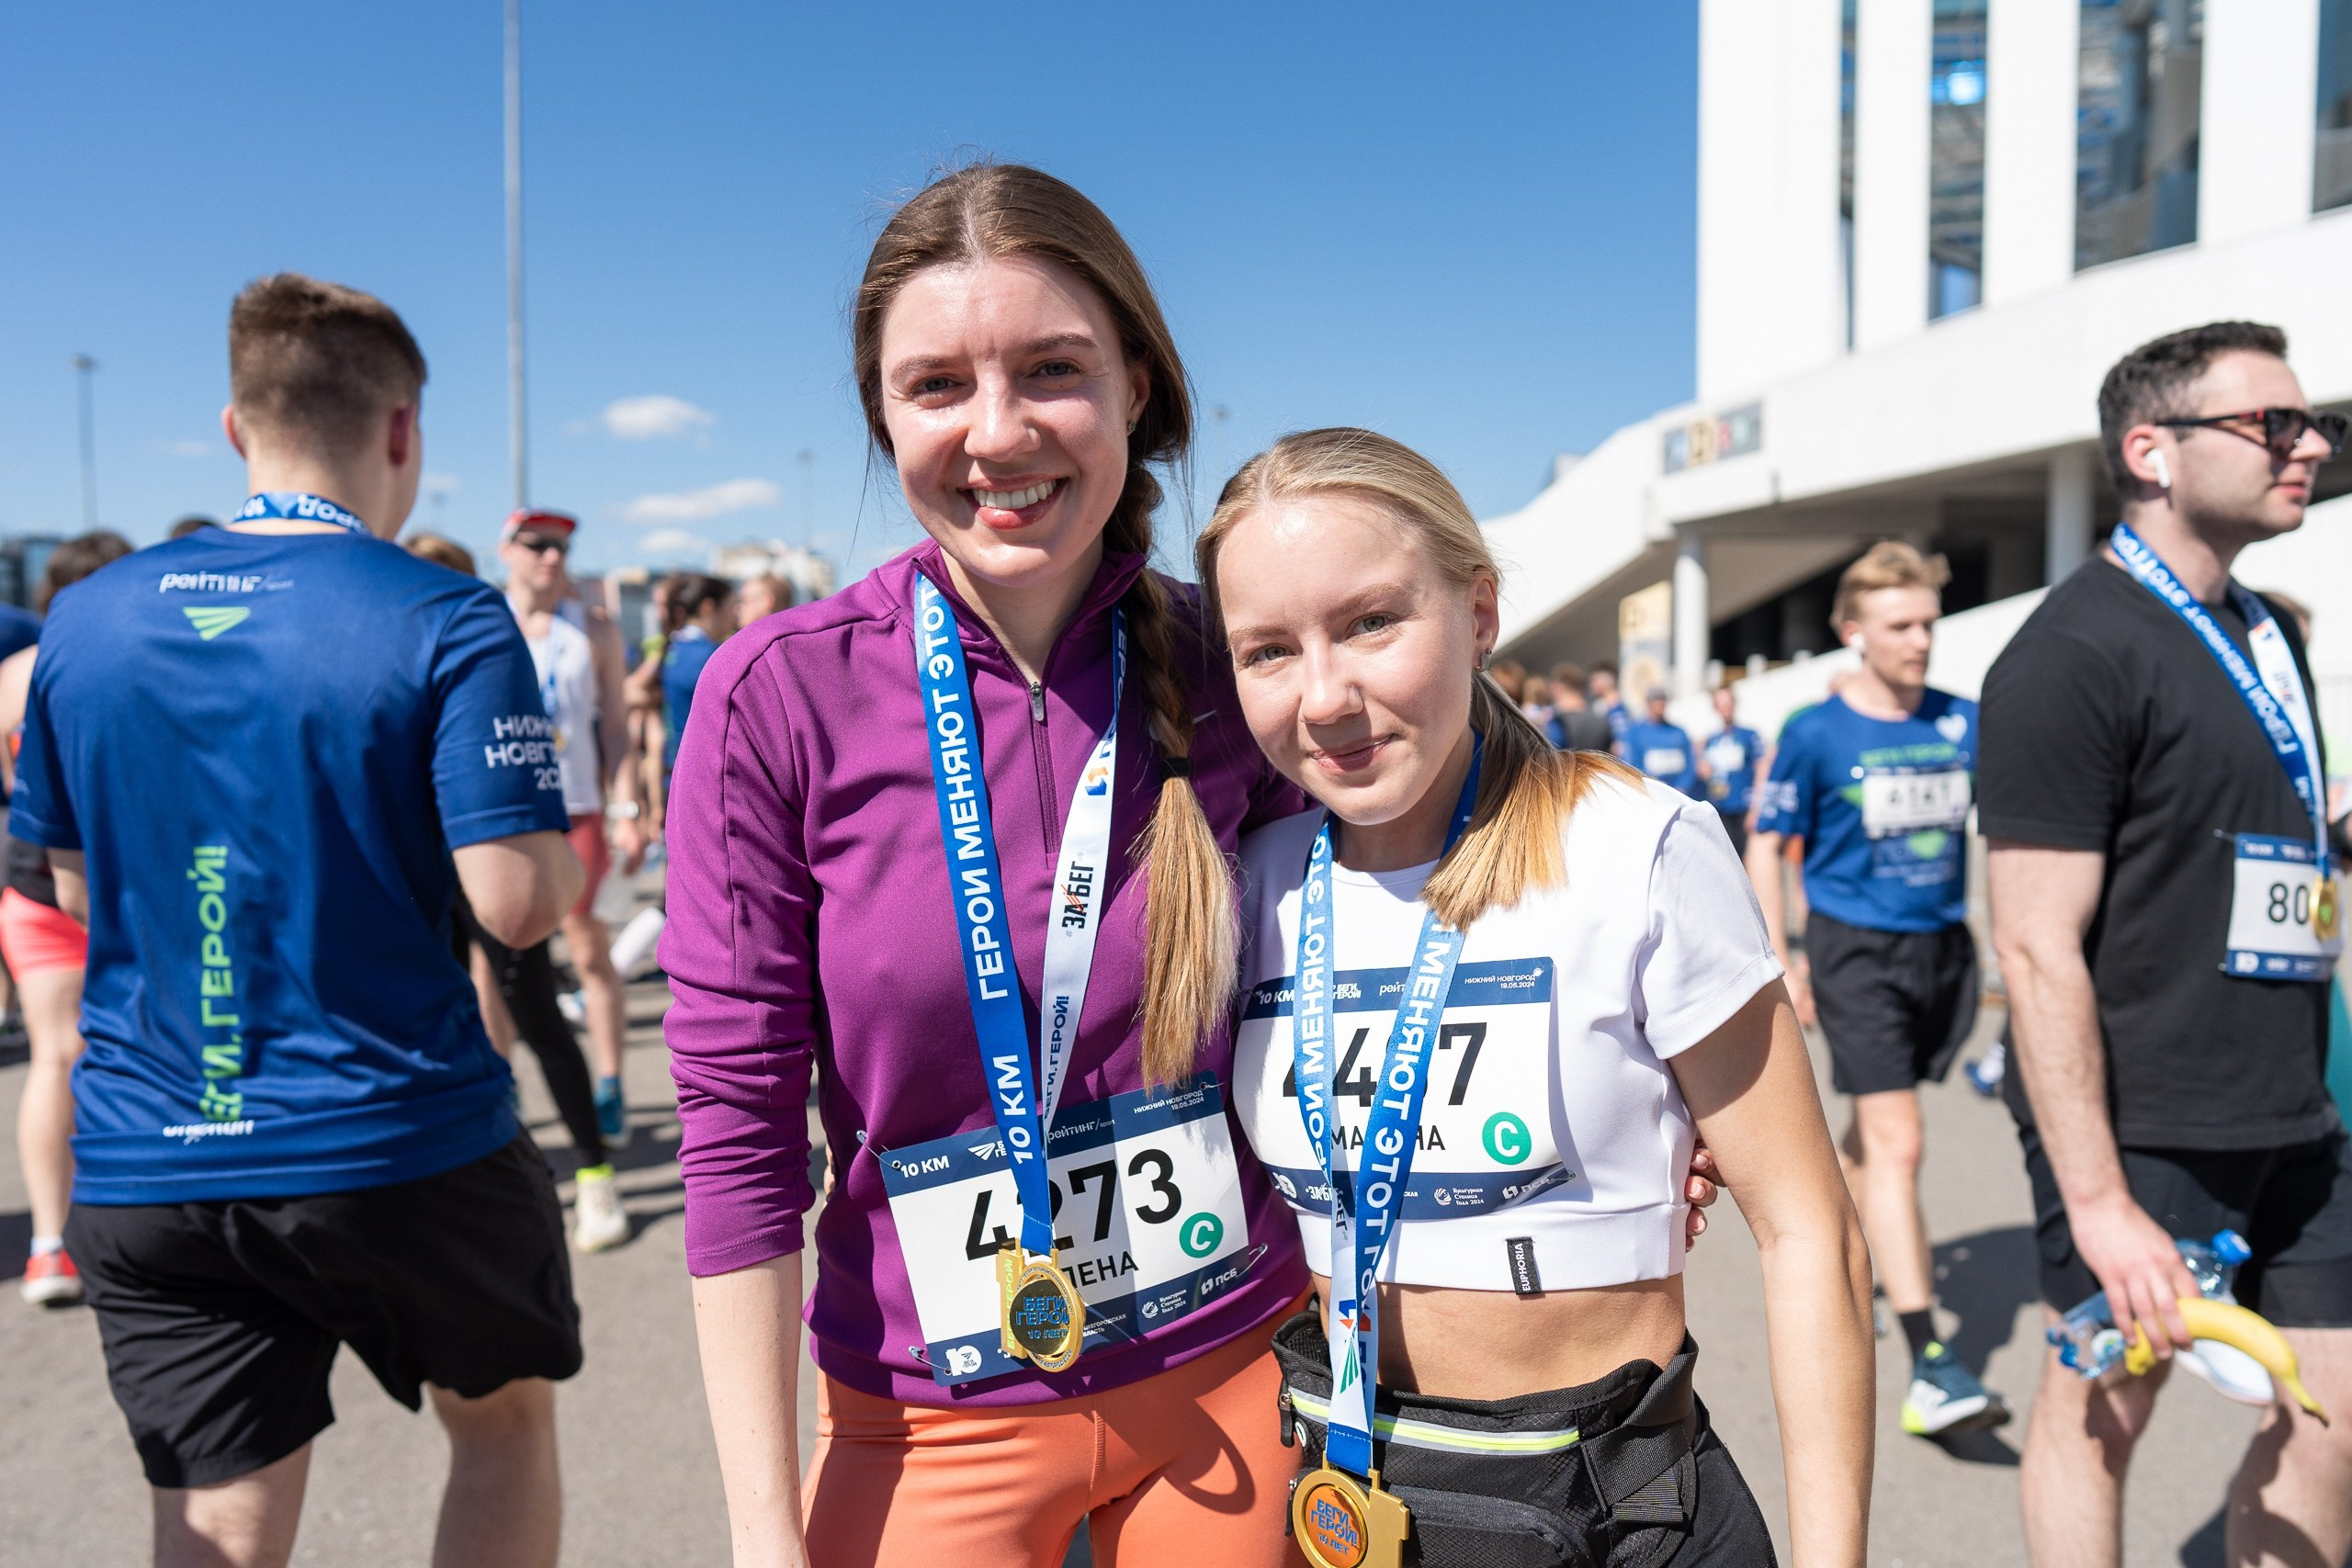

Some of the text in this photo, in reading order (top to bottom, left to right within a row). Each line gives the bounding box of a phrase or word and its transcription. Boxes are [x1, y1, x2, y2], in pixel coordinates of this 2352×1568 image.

[921, 587, 1033, 1166] 10 КМ ГЕРОИ МЕНЯЮТ ЭТОТ
[1306, 834, 1327, 905] ЭТО
[1260, 993, 1272, 1005] 10
[1302, 912, 1326, 1075] МЕНЯЮТ
[1379, 981, 1407, 996] рейт
[1464, 974, 1536, 985] НИЖНИЙ НОВГОРОД
[1050, 996, 1070, 1066] ГЕРОЙ!
[1383, 942, 1452, 1121] МЕНЯЮТ
[1283, 1021, 1487, 1108] 47
[1134, 1089, 1204, 1114] НИЖНИЙ НОВГОРОД
[1330, 1125, 1446, 1151] МАНА
[900, 1155, 950, 1179] 10 КМ
[1366, 1127, 1404, 1235] ЭТОТ
[1060, 1250, 1140, 1289] ЛЕНА
[1215, 1267, 1238, 1286] ПСБ
[1514, 1243, 1532, 1292] EUPHORIA
